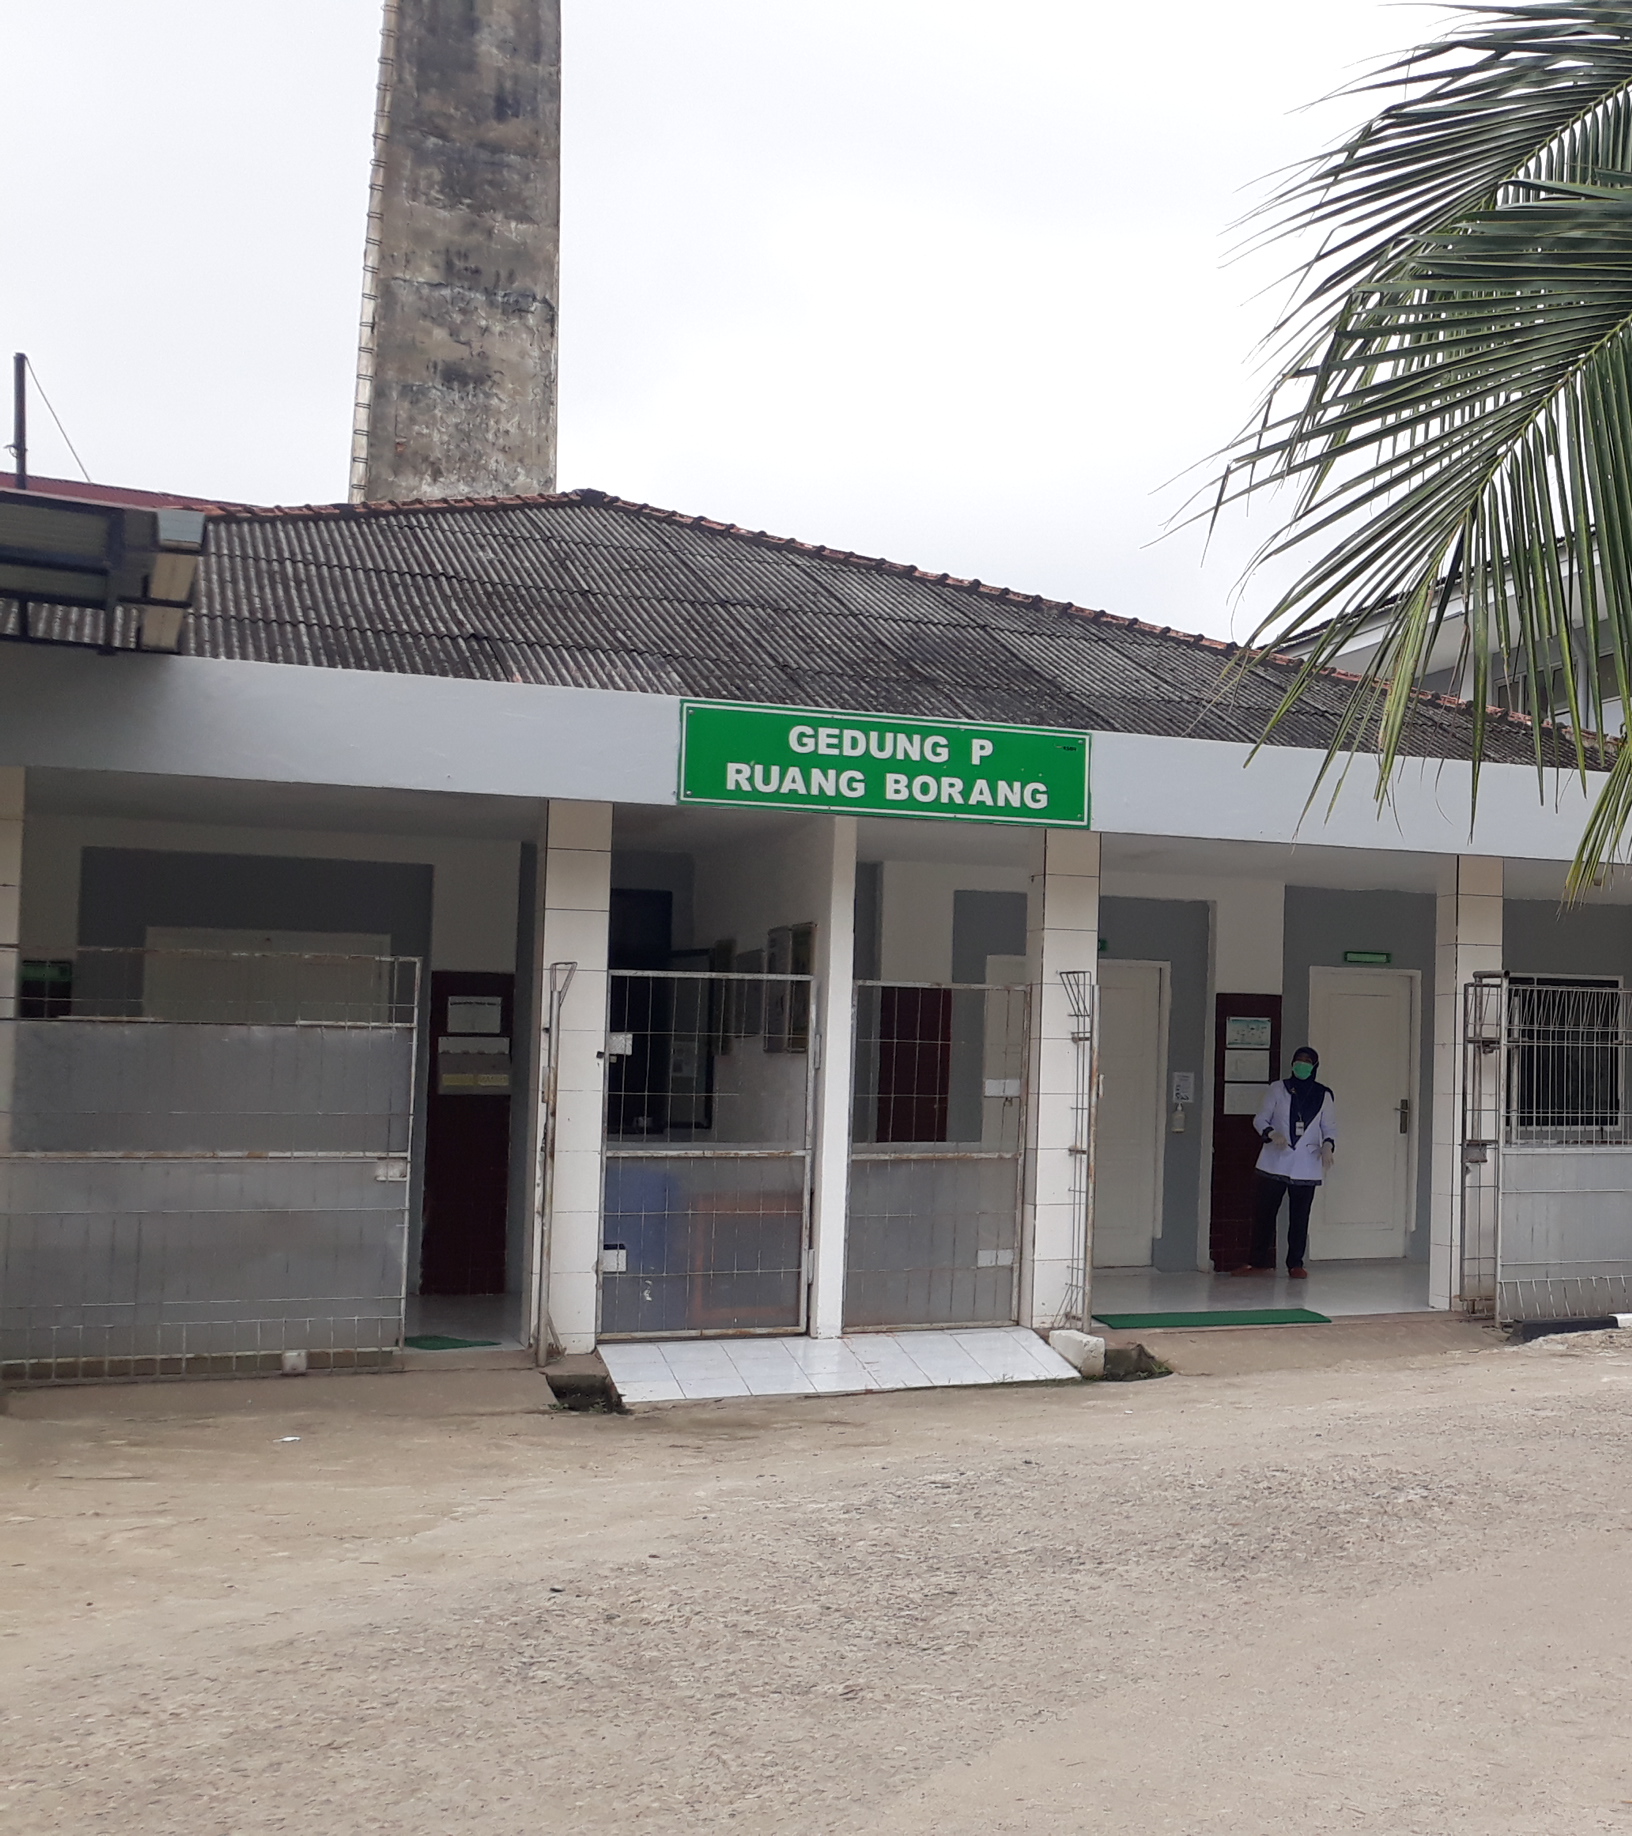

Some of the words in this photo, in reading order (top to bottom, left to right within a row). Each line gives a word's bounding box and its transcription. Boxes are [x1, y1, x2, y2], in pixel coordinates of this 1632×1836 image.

[788, 725, 950, 764] GEDUNG
[971, 738, 994, 765] P
[726, 762, 866, 798] RUANG
[885, 772, 1049, 810] BORANG
